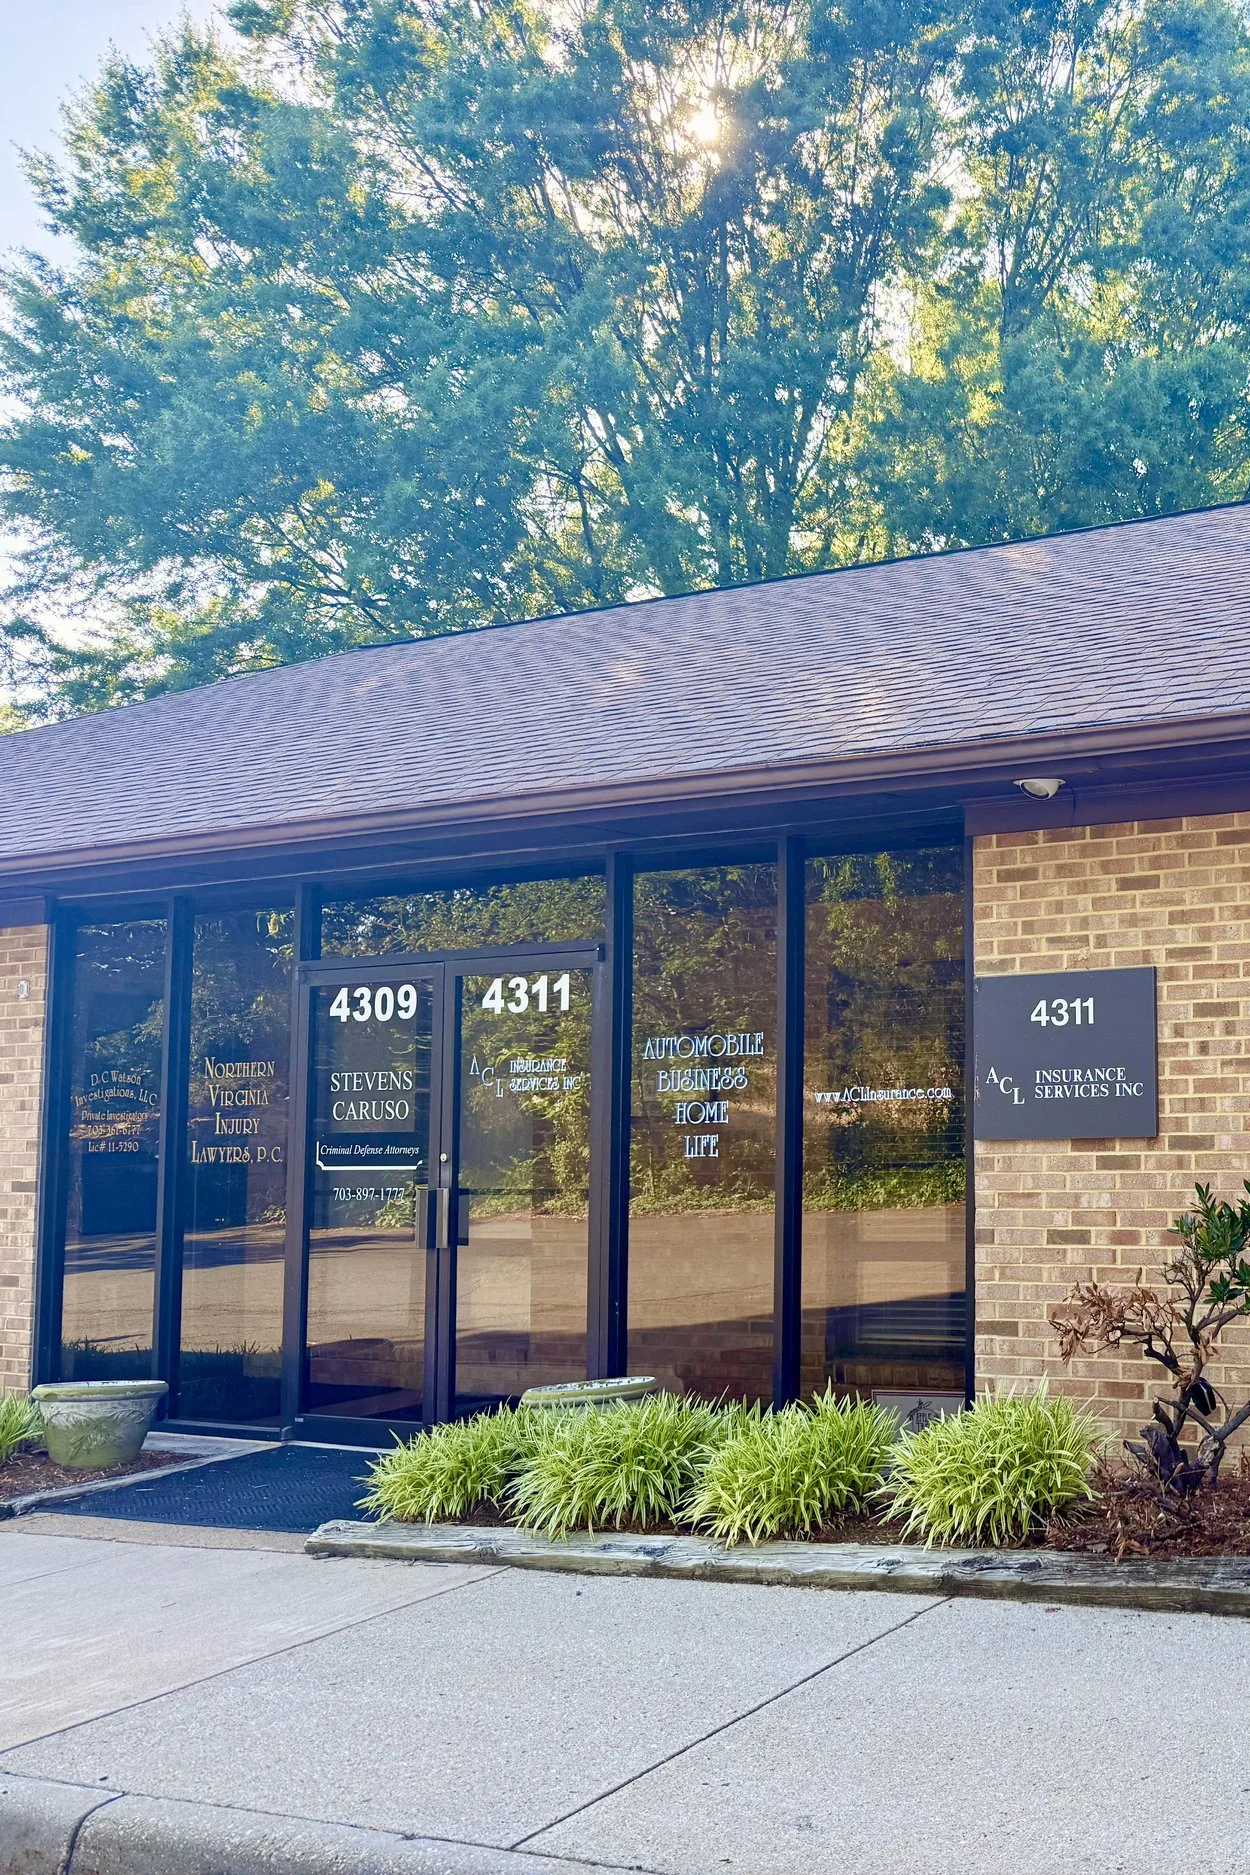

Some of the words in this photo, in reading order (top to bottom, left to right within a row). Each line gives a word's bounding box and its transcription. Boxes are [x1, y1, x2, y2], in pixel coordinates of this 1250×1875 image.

[329, 984, 418, 1023] 4309
[482, 974, 570, 1015] 4311
[1030, 997, 1095, 1027] 4311
[642, 1031, 764, 1060] AUTOMOBILE
[203, 1056, 276, 1079] NORTHERN
[509, 1058, 567, 1073] INSURANCE
[1034, 1067, 1127, 1084] INSURANCE
[110, 1070, 142, 1086] Watson
[330, 1071, 413, 1092] STEVENS
[509, 1078, 560, 1091] SERVICES
[562, 1075, 582, 1090] INC
[657, 1066, 748, 1092] BUSINESS
[138, 1088, 158, 1106] LLC
[208, 1084, 269, 1107] VIRGINIA
[1034, 1083, 1109, 1099] SERVICES
[1114, 1082, 1144, 1097] INC
[81, 1110, 106, 1121] Private
[332, 1099, 410, 1121] CARUSO
[674, 1100, 729, 1125] HOME
[214, 1112, 260, 1135] INJURY
[108, 1141, 139, 1153] 11-5290
[191, 1140, 254, 1164] LAWYERS,
[320, 1144, 353, 1155] Criminal
[354, 1144, 383, 1157] Defense
[384, 1145, 420, 1157] Attorneys
[684, 1133, 719, 1158] LIFE
[333, 1187, 405, 1201] 703-897-1777
